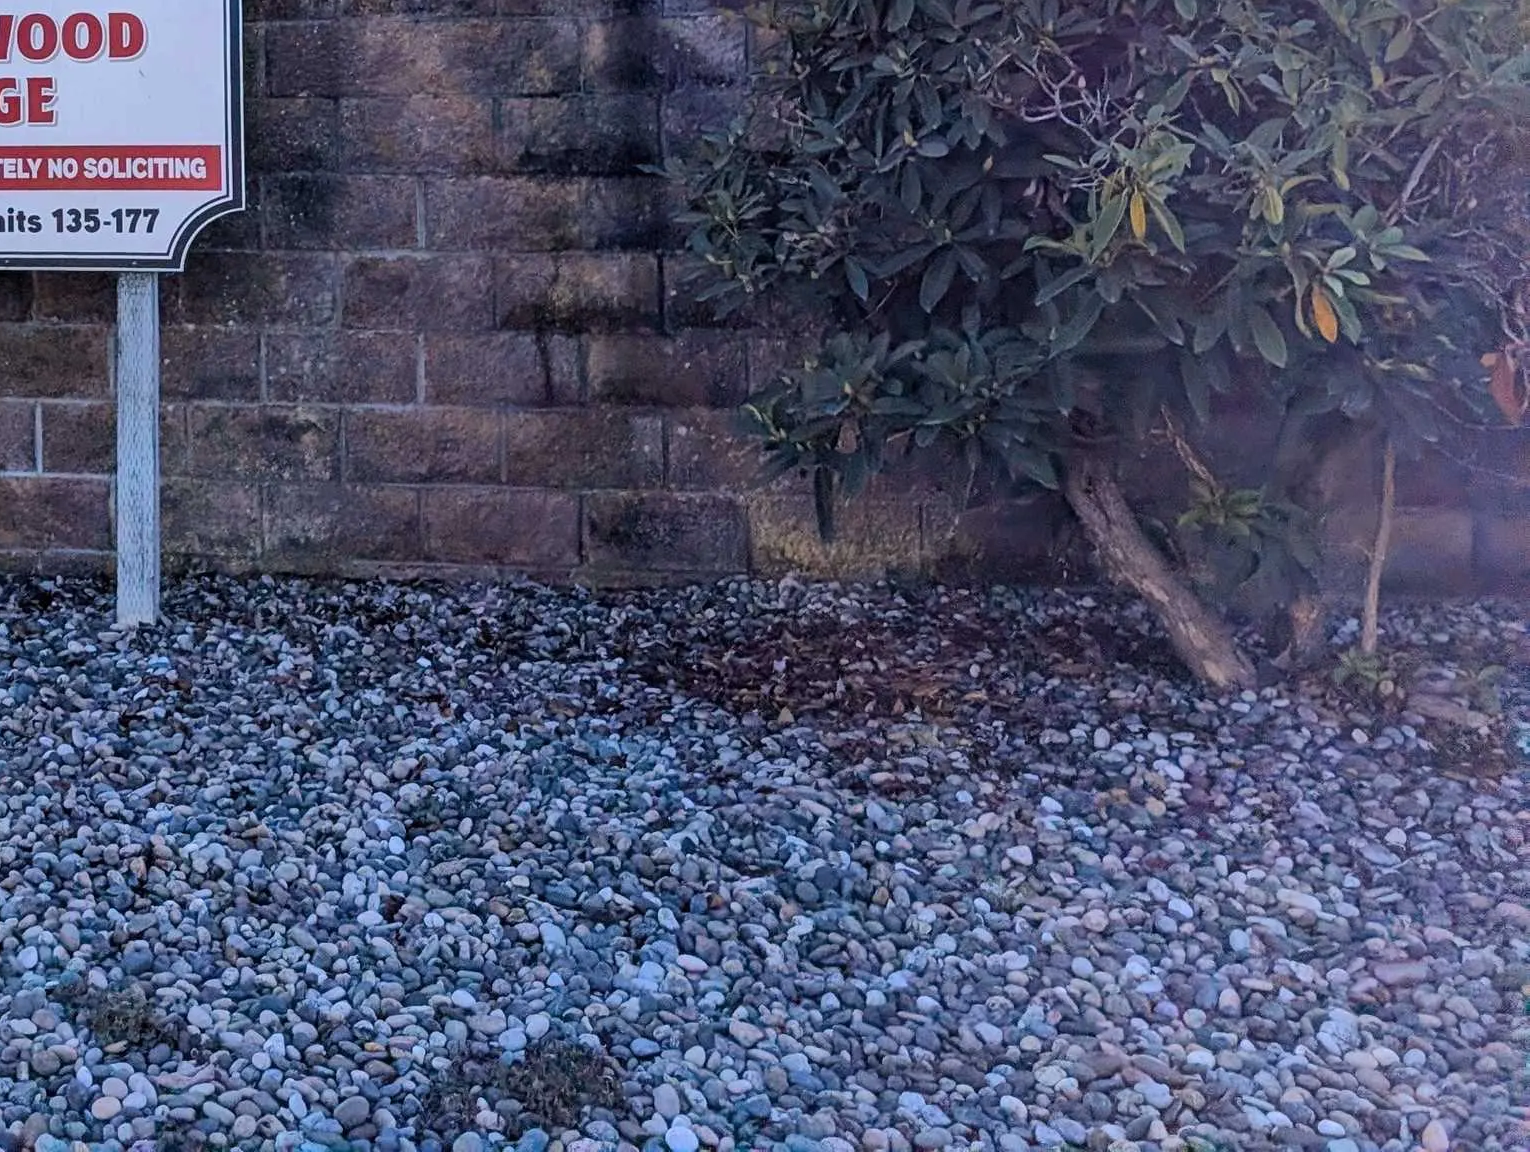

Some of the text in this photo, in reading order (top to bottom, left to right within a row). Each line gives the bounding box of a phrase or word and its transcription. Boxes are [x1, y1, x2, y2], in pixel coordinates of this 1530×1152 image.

[47, 157, 78, 179] NO
[83, 157, 207, 179] SOLICITING
[51, 208, 160, 233] 135-177
